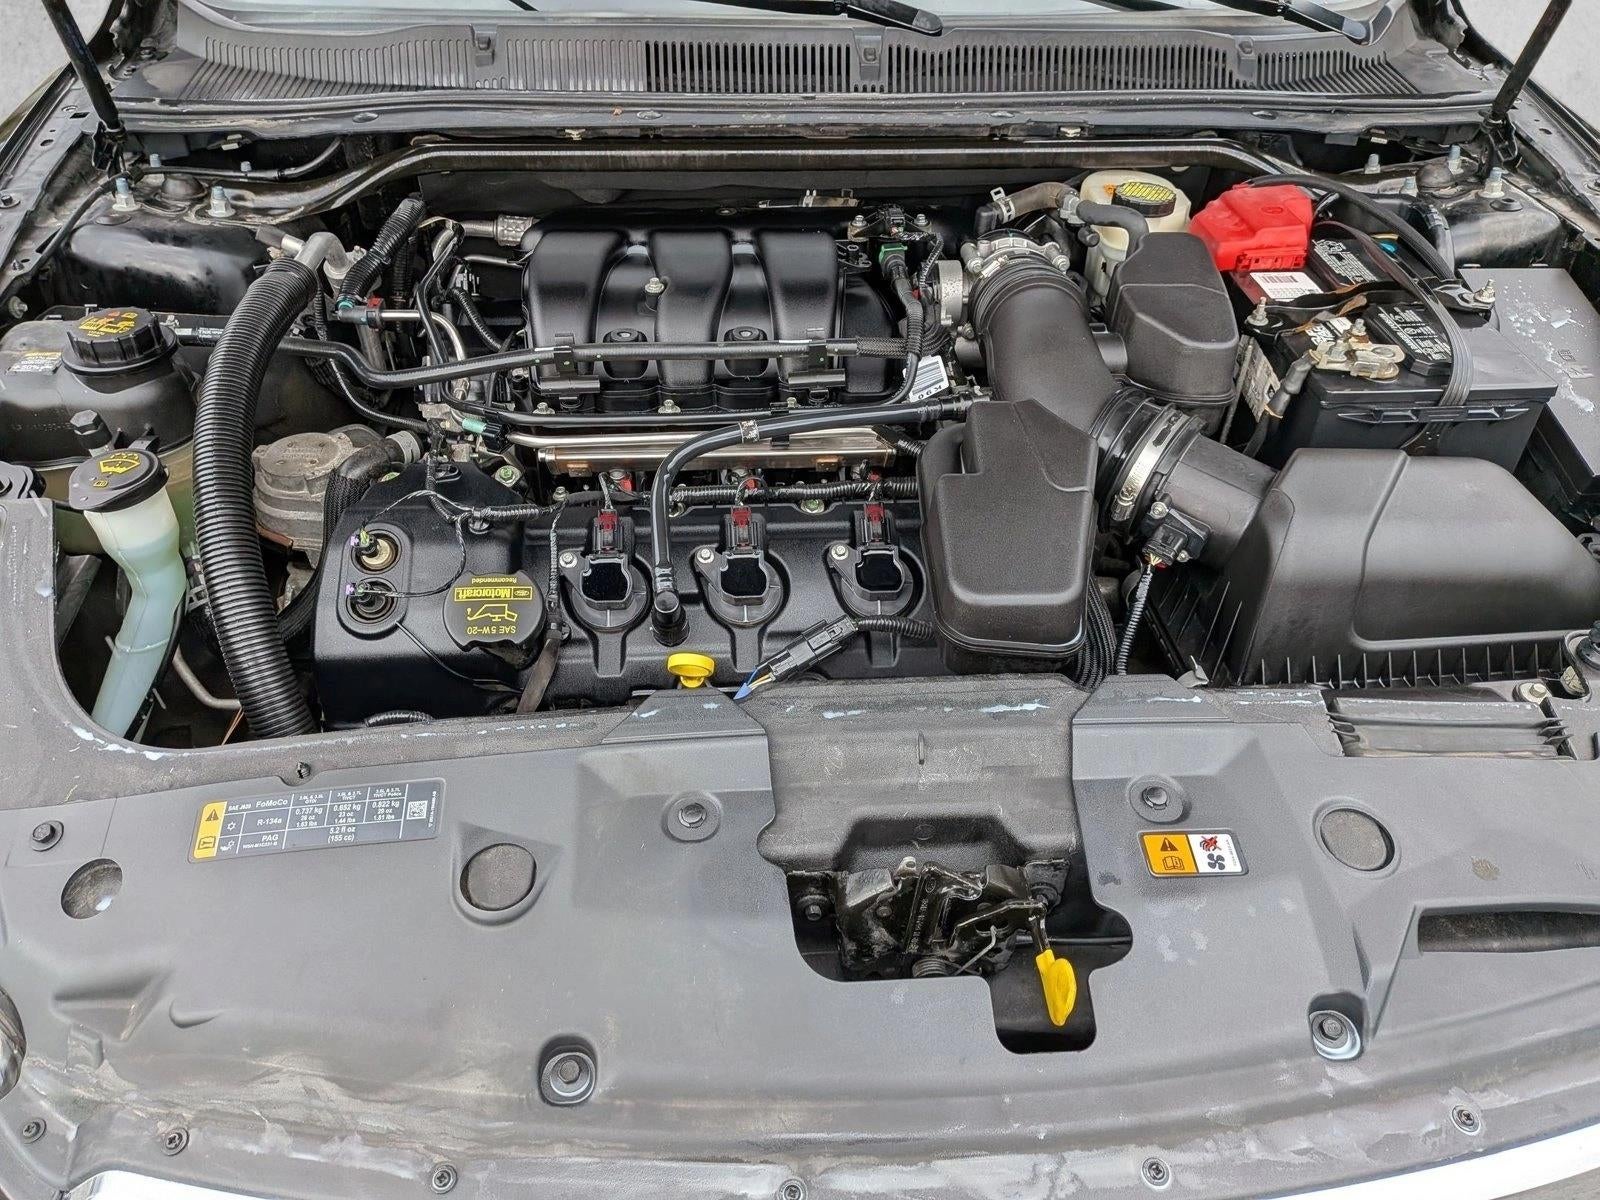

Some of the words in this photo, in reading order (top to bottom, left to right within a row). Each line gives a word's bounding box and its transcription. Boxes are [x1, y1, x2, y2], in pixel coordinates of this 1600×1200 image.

[457, 588, 511, 599] Motorcraft
[466, 626, 497, 634] 5W-20
[499, 625, 517, 634] SAE
[255, 799, 288, 808] FoMoCo
[352, 803, 361, 811] kg
[372, 800, 390, 808] 0.822
[391, 800, 400, 808] kg
[295, 807, 313, 815] 0.737
[314, 806, 323, 815] kg
[256, 817, 282, 826] R-134a
[329, 826, 340, 834] 5.2
[261, 834, 279, 842] PAG
[327, 834, 343, 844] (155
[343, 833, 355, 842] cc)
